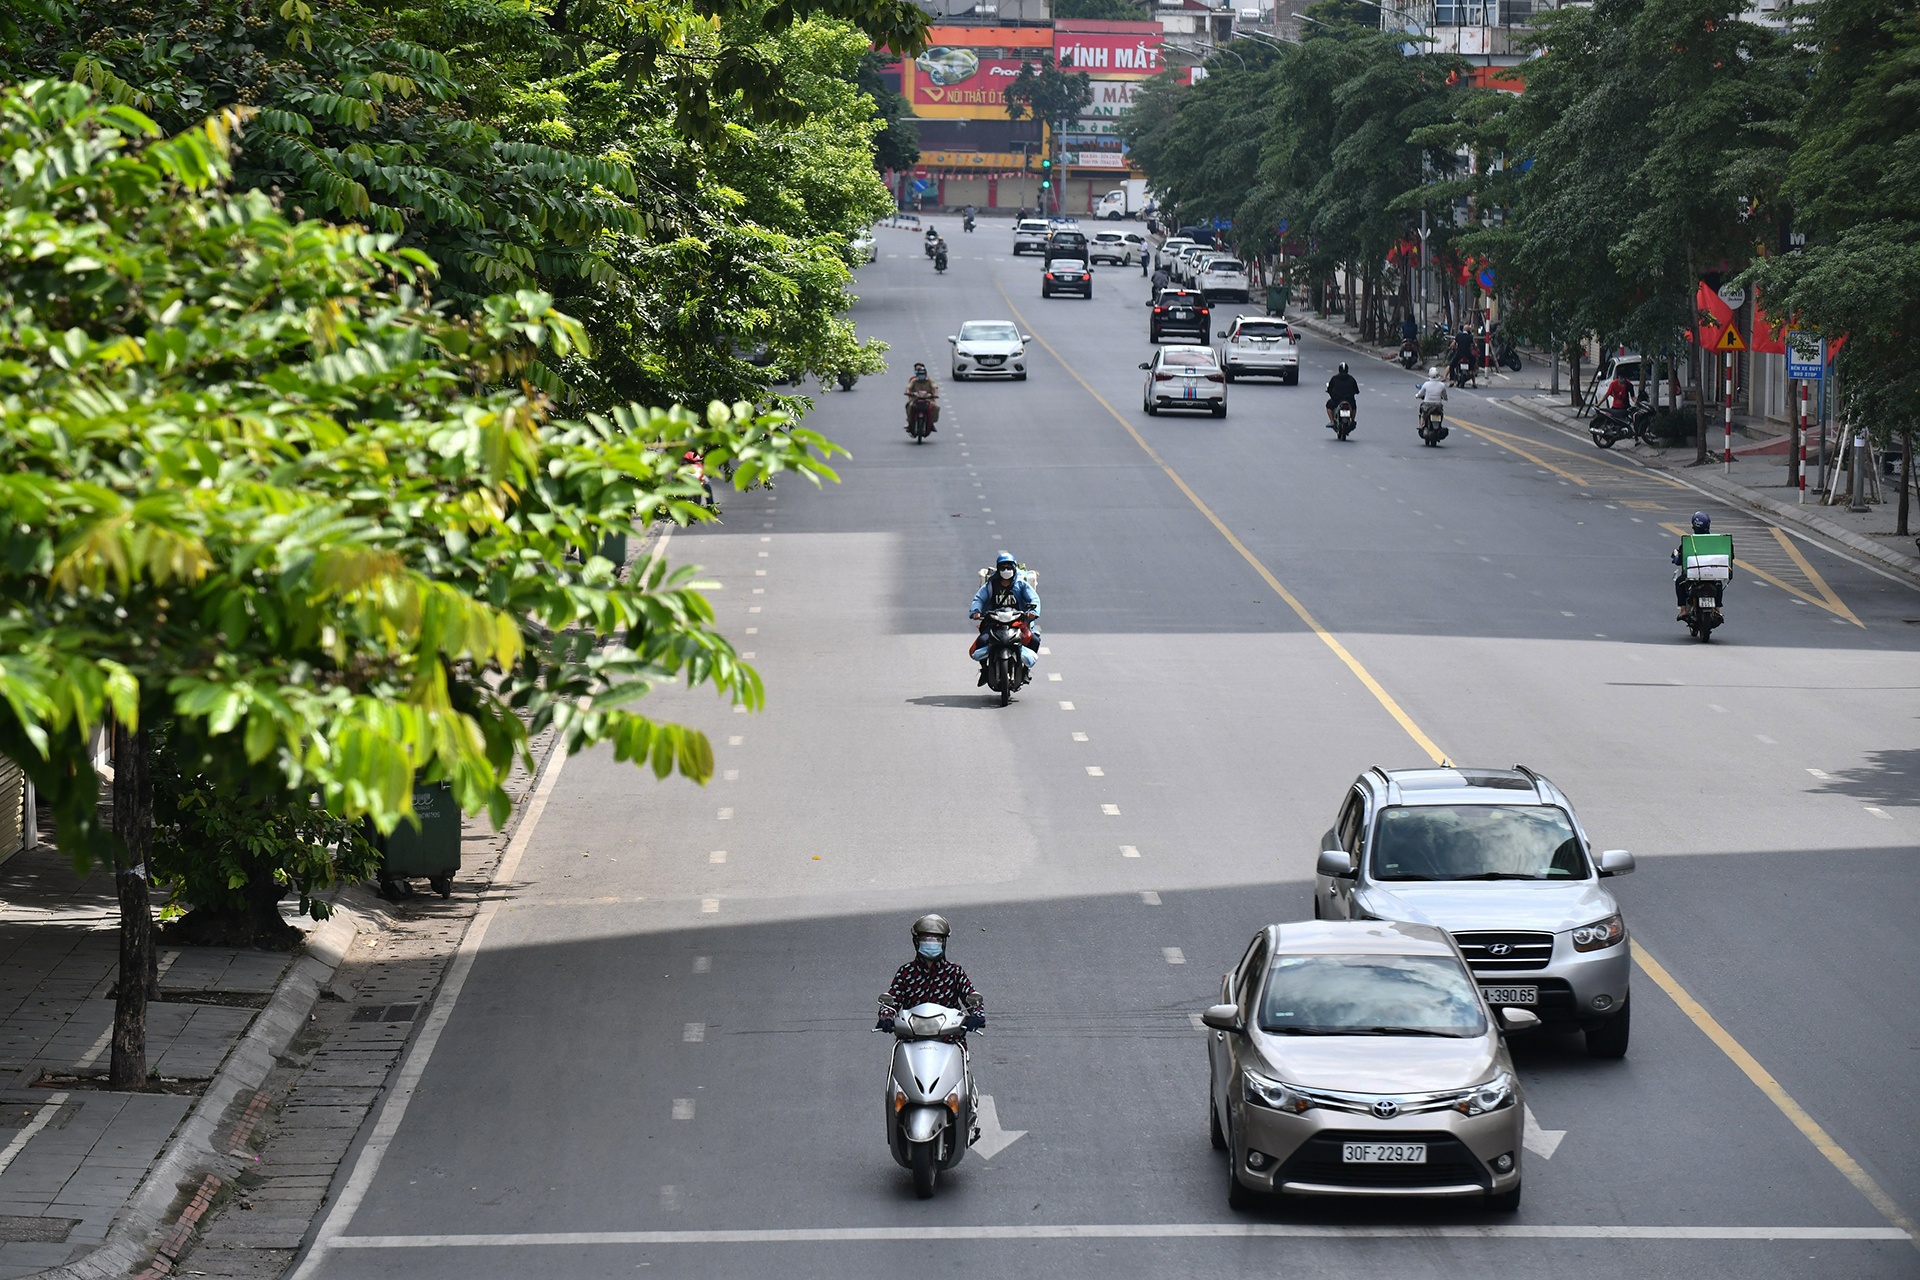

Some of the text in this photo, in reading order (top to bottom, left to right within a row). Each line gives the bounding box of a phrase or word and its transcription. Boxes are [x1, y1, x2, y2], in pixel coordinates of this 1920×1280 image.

[1060, 41, 1159, 69] KÍNH MẮT
[989, 66, 1043, 77] Pioner
[947, 88, 962, 103] NỘI
[965, 86, 987, 103] THẤT
[989, 88, 995, 103] Ô
[1092, 106, 1113, 116] AN
[1483, 989, 1535, 1003] A-390.65
[1345, 1145, 1424, 1162] 30F-229.27
